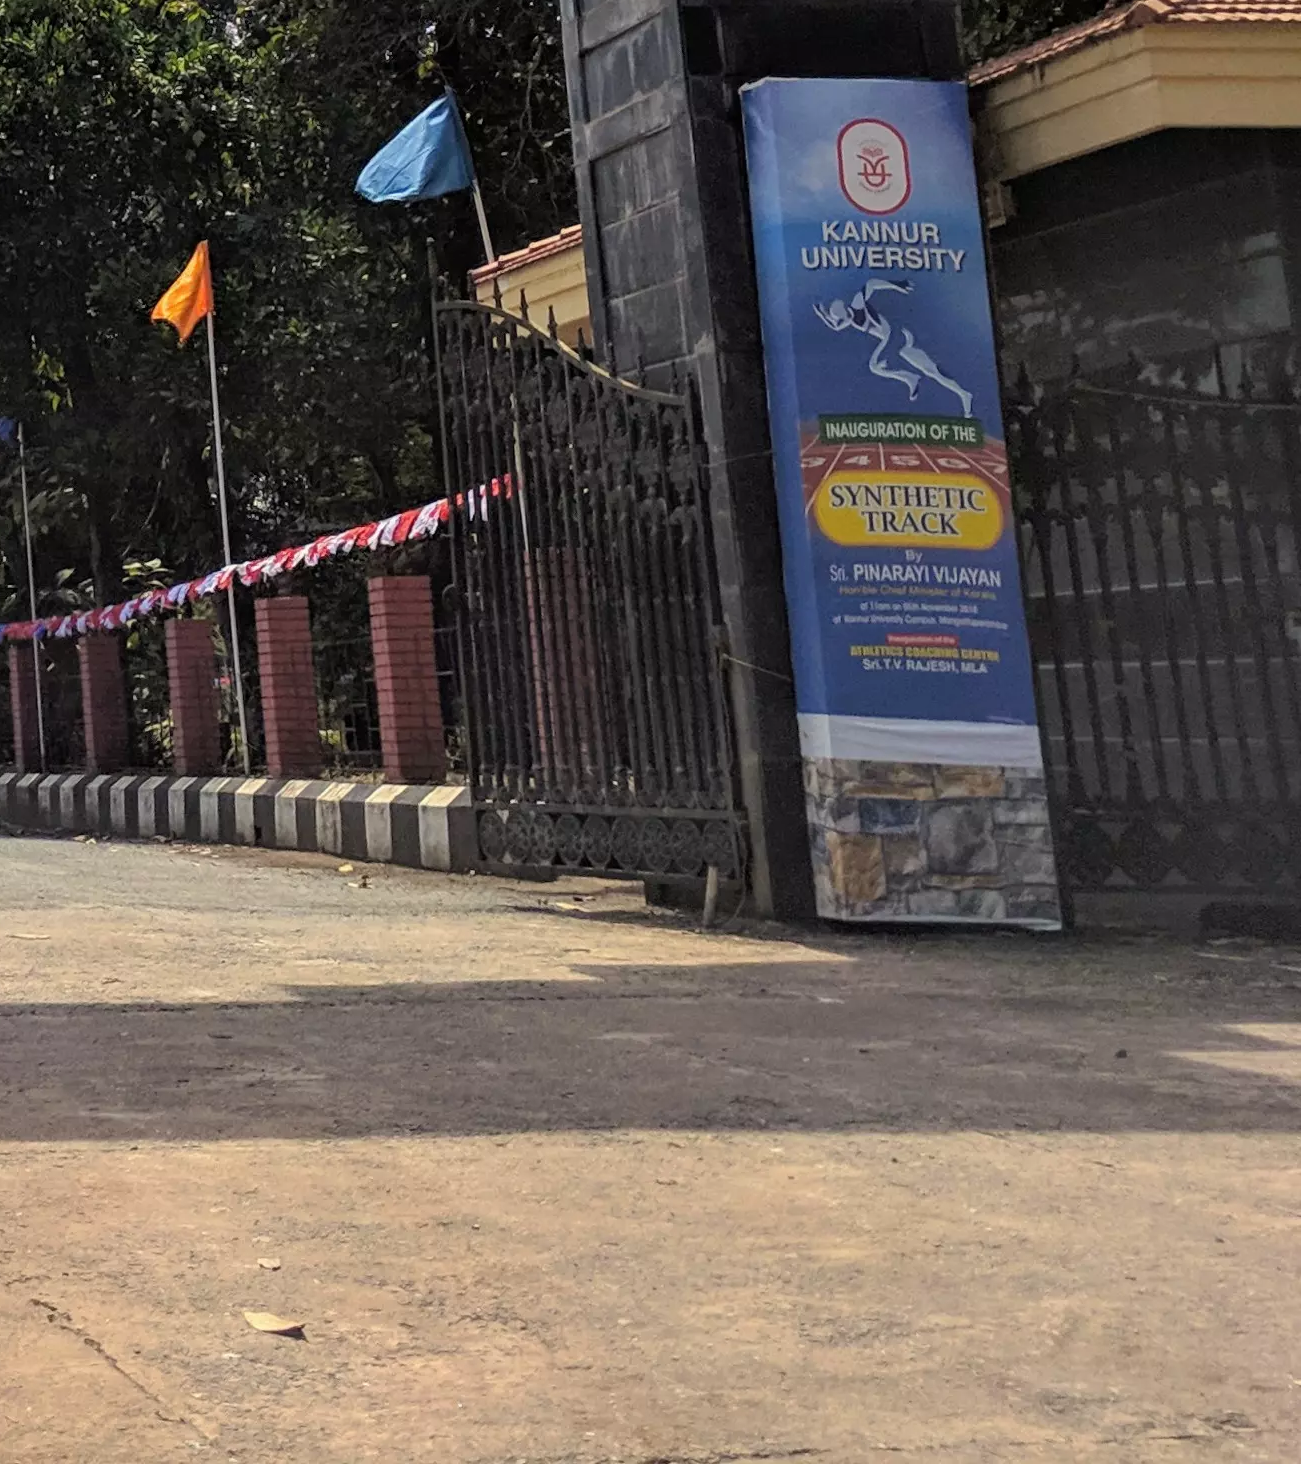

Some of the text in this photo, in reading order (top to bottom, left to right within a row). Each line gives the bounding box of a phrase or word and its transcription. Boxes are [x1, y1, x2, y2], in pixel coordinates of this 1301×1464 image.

[822, 221, 940, 244] KANNUR
[801, 247, 966, 272] UNIVERSITY
[826, 422, 977, 442] INAUGURATION OF THE
[844, 455, 871, 465] 4
[830, 484, 986, 511] SYNTHETIC
[861, 510, 960, 536] TRACK
[905, 549, 923, 563] By
[829, 564, 1001, 587] Sri. PINARAYI VIJAYAN
[881, 585, 906, 595] Chief
[961, 663, 988, 674] MLA
